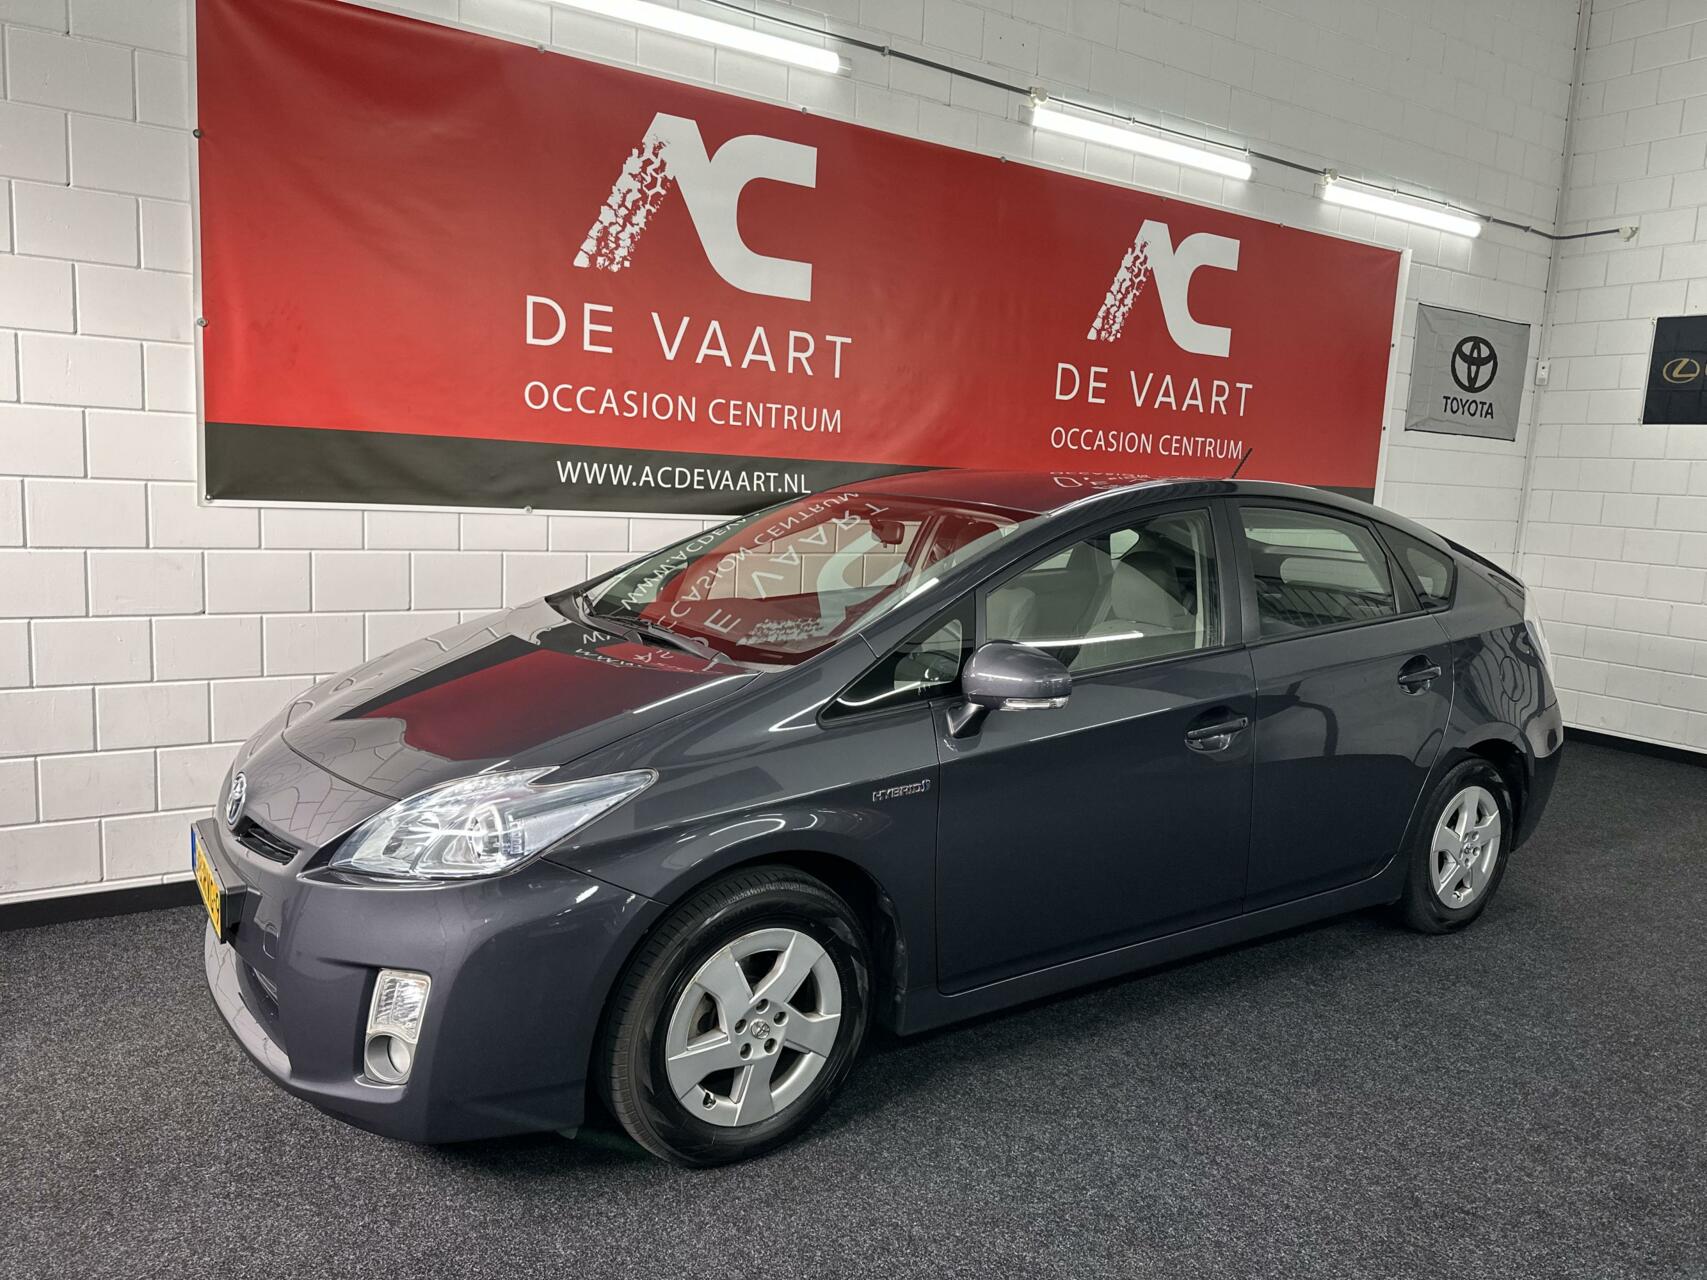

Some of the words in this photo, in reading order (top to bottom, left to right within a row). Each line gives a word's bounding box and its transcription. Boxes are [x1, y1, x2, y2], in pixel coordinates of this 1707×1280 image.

[573, 111, 818, 302] AC
[1087, 219, 1240, 358] AC
[525, 294, 614, 354] DE
[651, 311, 852, 379] VAART
[524, 381, 696, 422] OCCASION
[708, 398, 841, 433] CENTRUM
[1055, 362, 1109, 404] DE
[1130, 370, 1253, 417] VAART
[1442, 395, 1494, 420] TOYOTA
[1051, 426, 1153, 454] OCCASION
[1159, 434, 1242, 460] CENTRUM
[556, 460, 812, 494] WWW.ACDEVAART.NL
[872, 783, 922, 802] HYBRID
